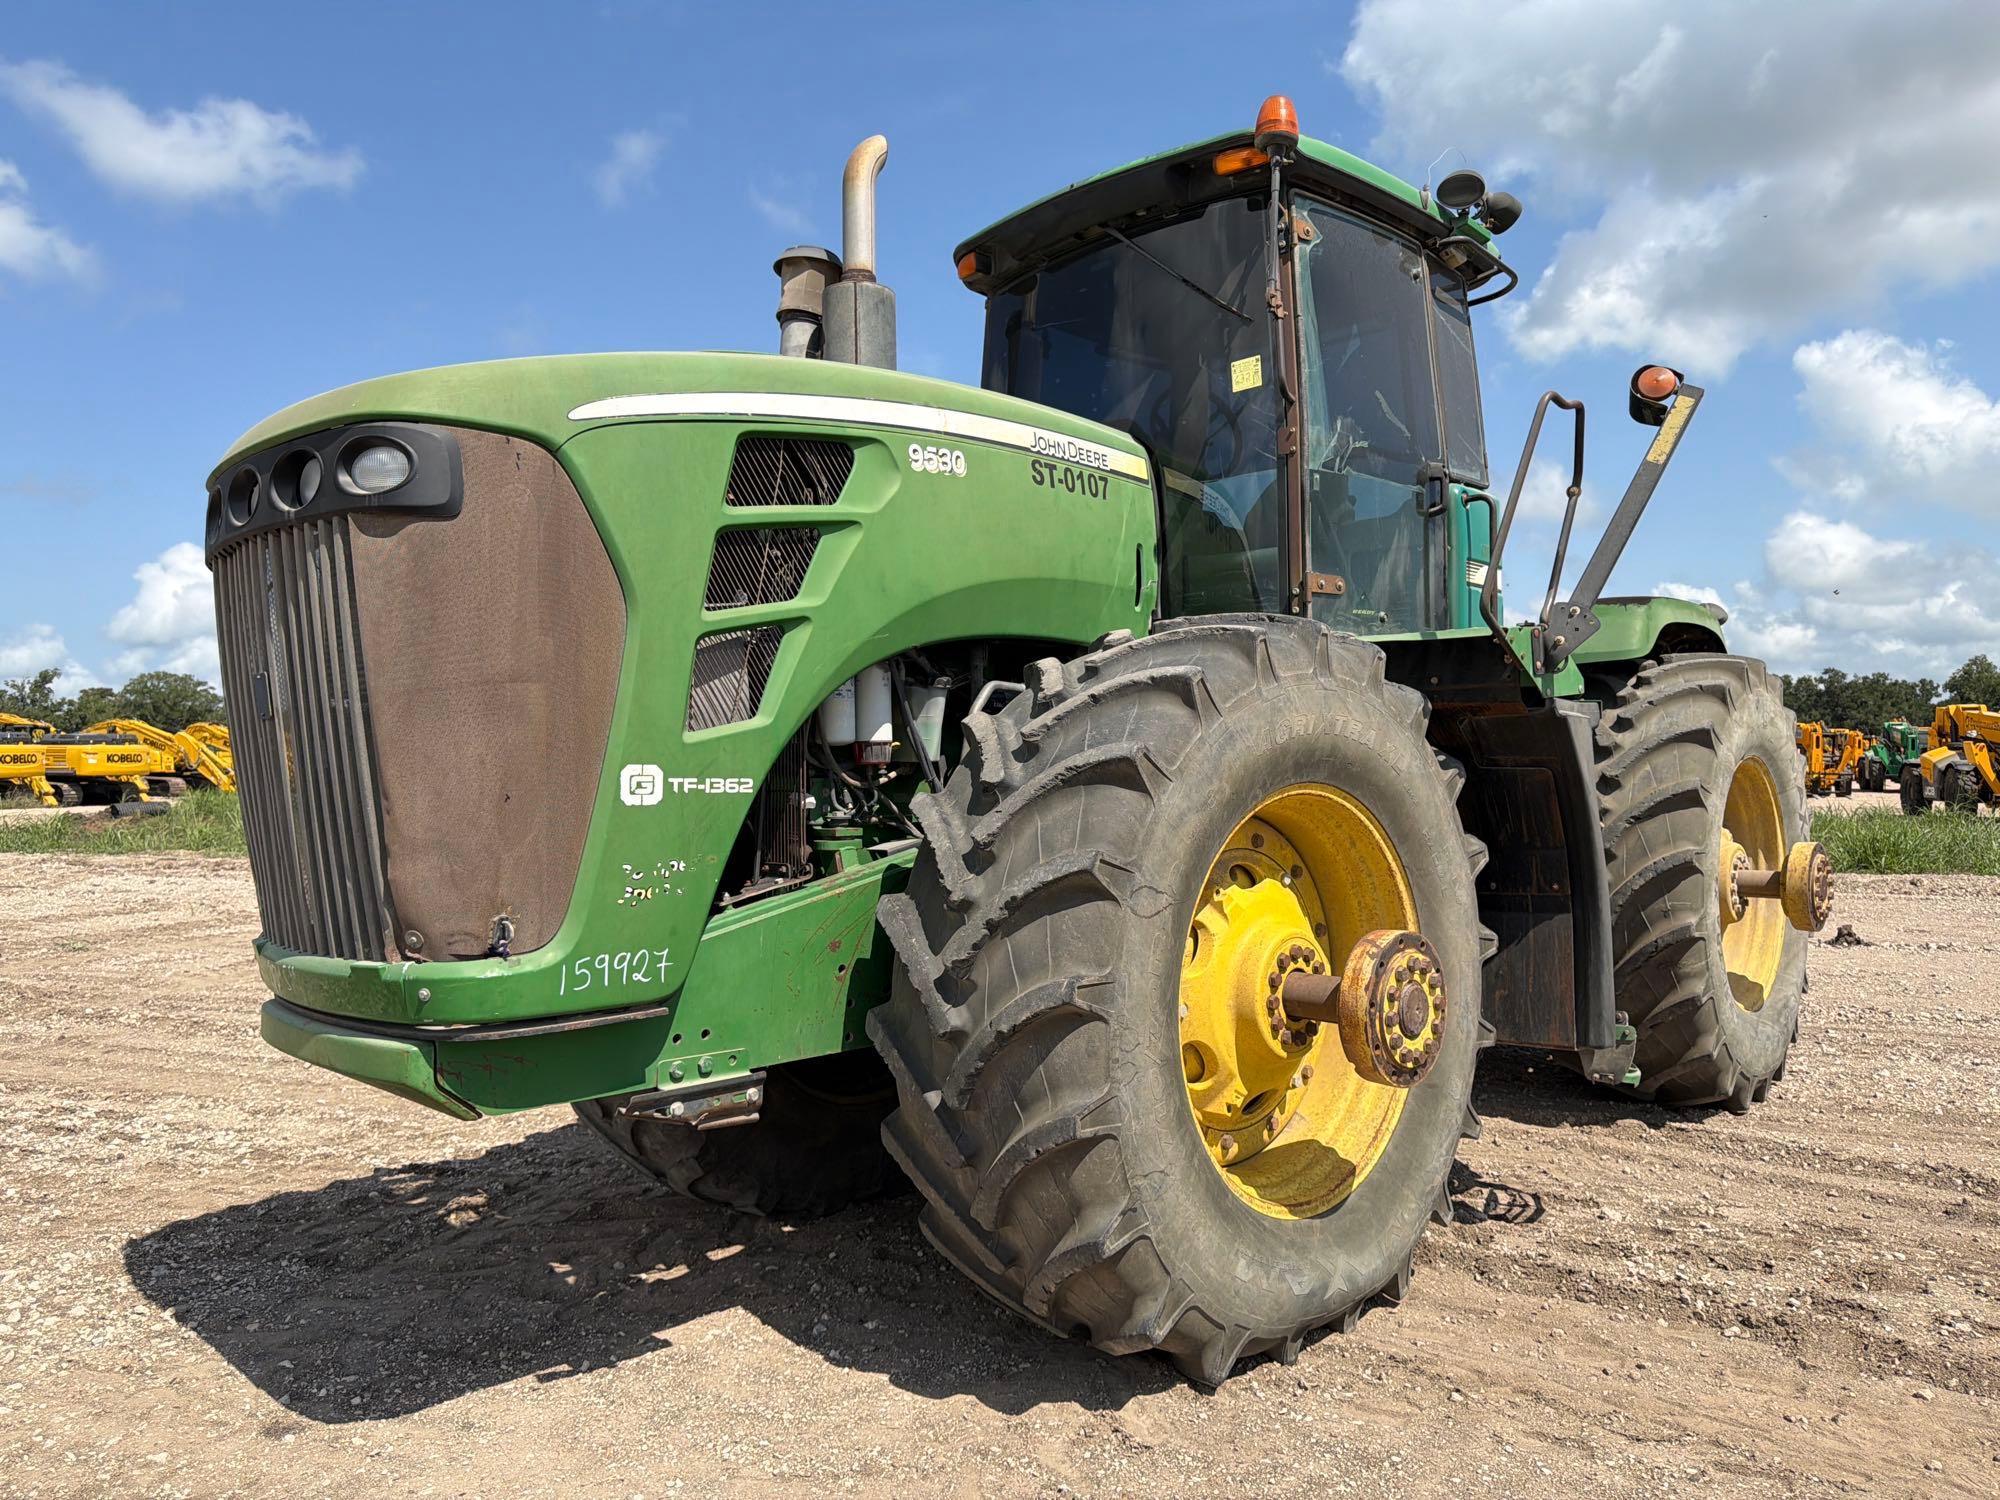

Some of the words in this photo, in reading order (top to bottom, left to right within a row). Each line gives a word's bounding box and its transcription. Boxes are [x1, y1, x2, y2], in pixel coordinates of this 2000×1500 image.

[908, 443, 967, 477] 9530
[1030, 431, 1066, 457] JOHN
[1067, 441, 1109, 468] DEERE
[1030, 459, 1109, 500] ST-0107
[106, 753, 143, 764] KOBELCO
[667, 777, 754, 795] TF-1362
[559, 948, 674, 996] 159927
